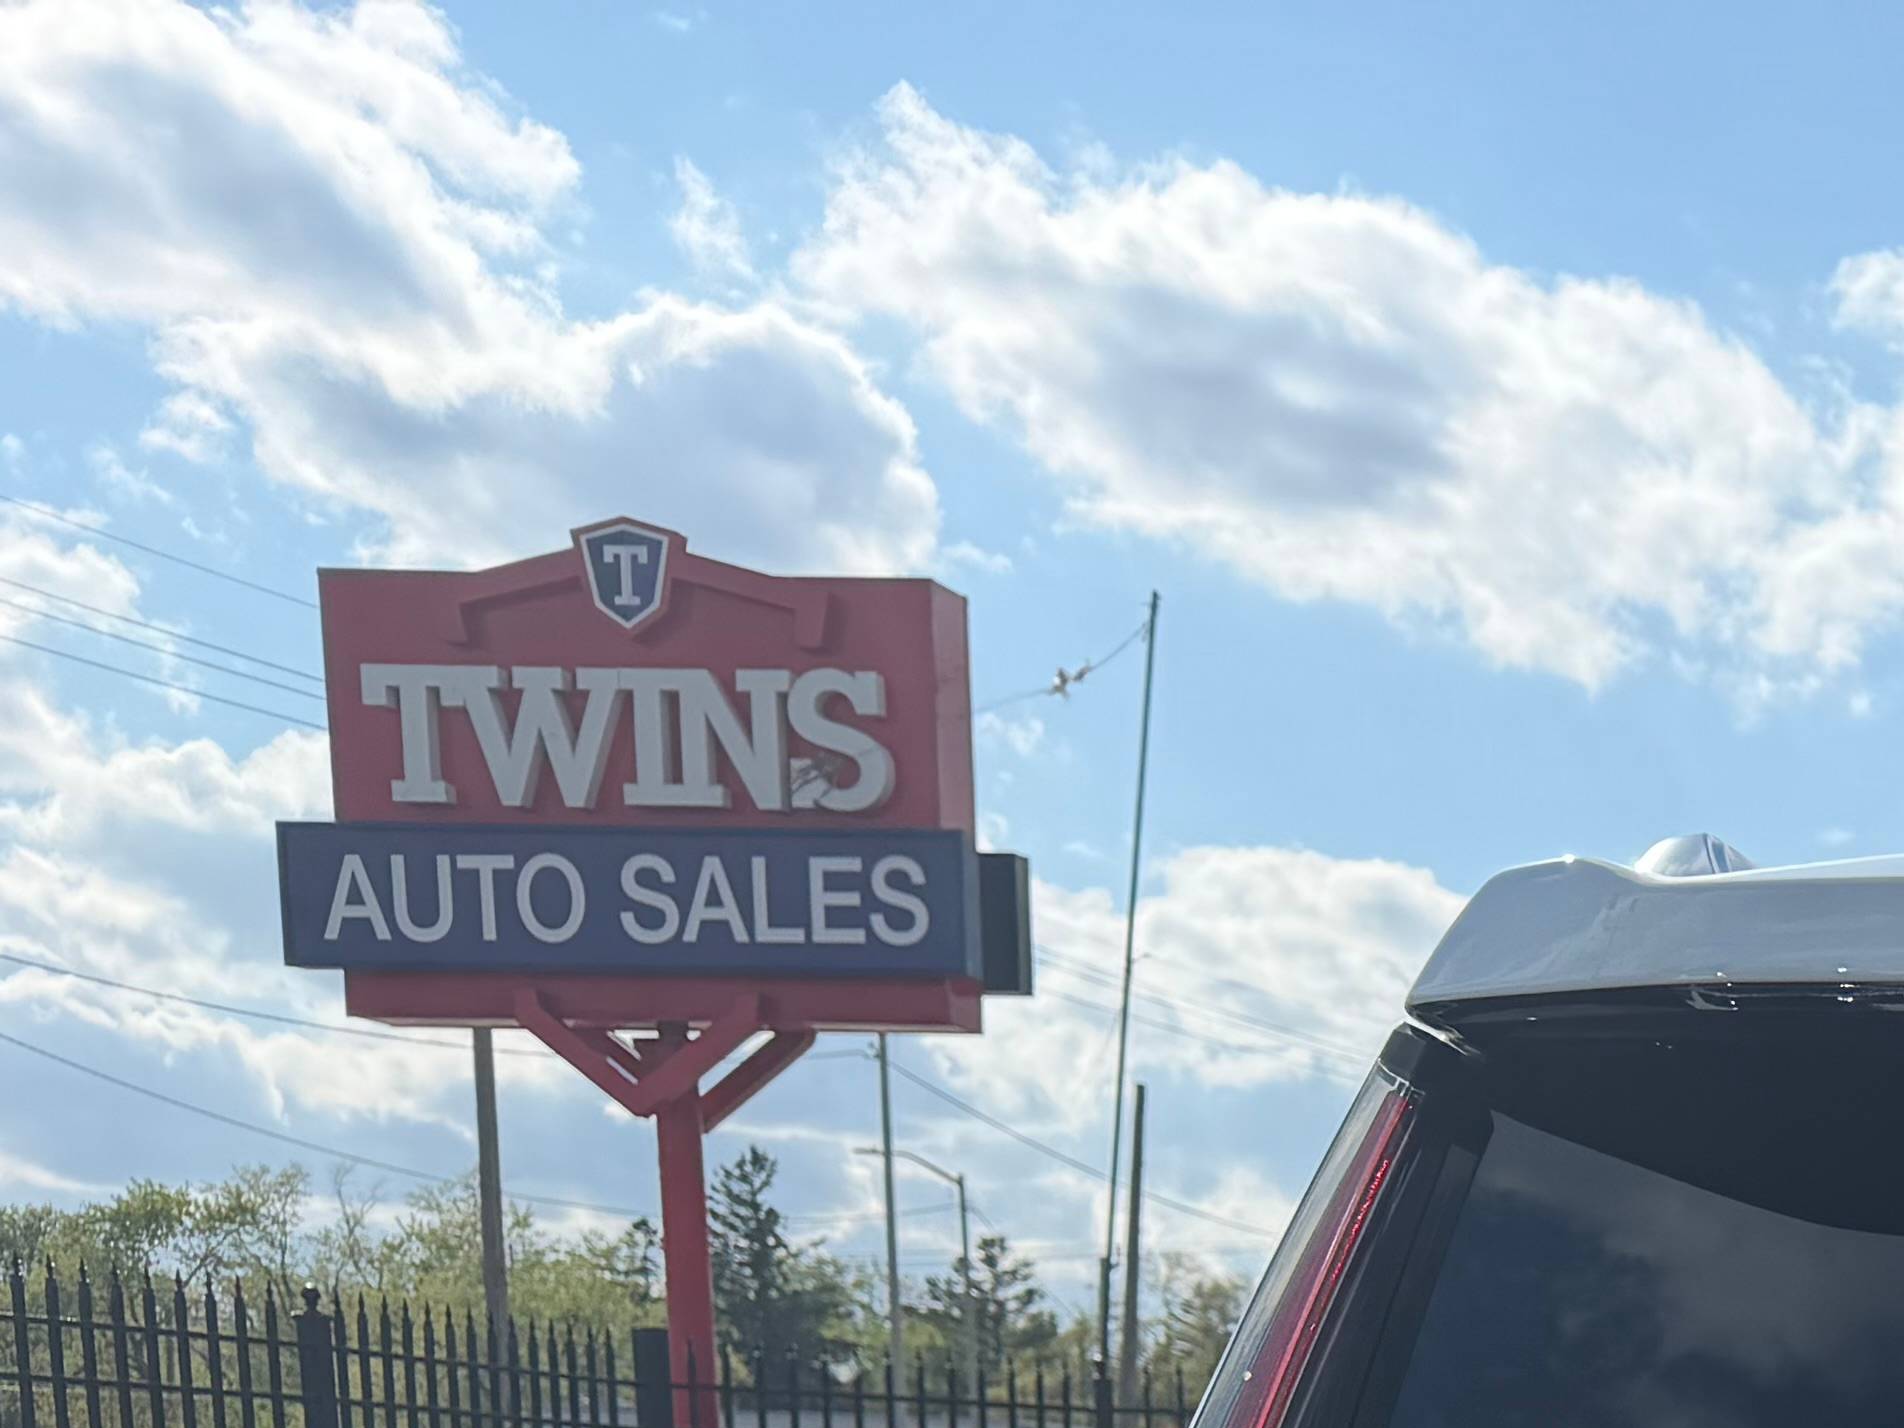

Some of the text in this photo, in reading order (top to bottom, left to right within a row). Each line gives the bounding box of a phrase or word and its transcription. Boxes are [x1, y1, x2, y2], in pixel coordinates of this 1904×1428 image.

[603, 545, 648, 606] T
[360, 663, 896, 812] TWINS
[323, 852, 930, 947] AUTO SALES
